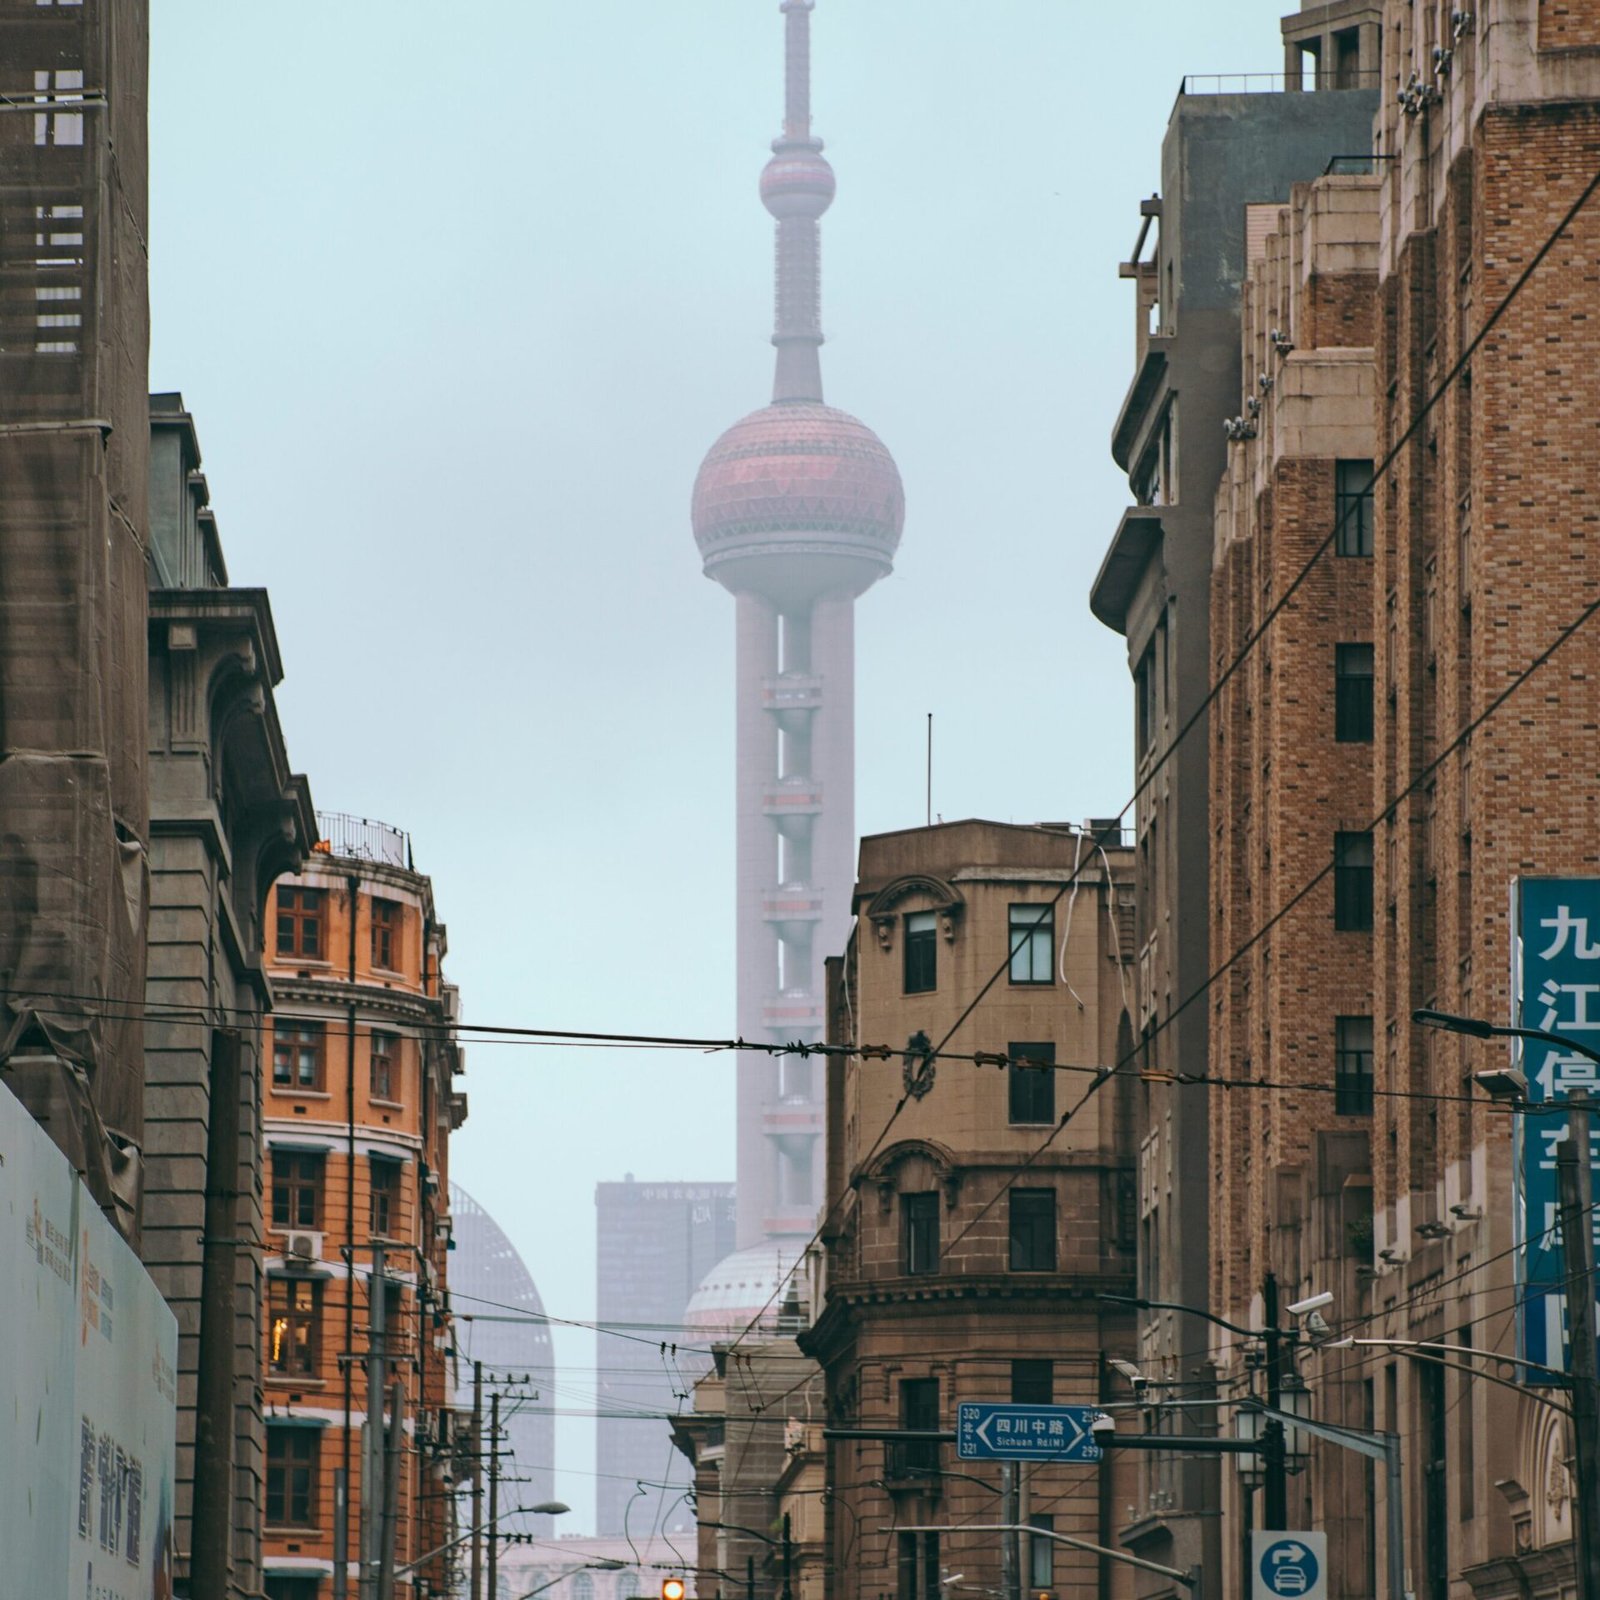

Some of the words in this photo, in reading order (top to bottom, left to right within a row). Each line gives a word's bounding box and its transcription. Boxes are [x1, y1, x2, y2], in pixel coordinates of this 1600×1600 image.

[963, 1408, 980, 1419] 320
[963, 1422, 973, 1433] 北
[996, 1419, 1064, 1435] 四川中路
[996, 1437, 1033, 1447] Sichuan
[963, 1443, 977, 1455] 321
[1081, 1446, 1099, 1458] 299
